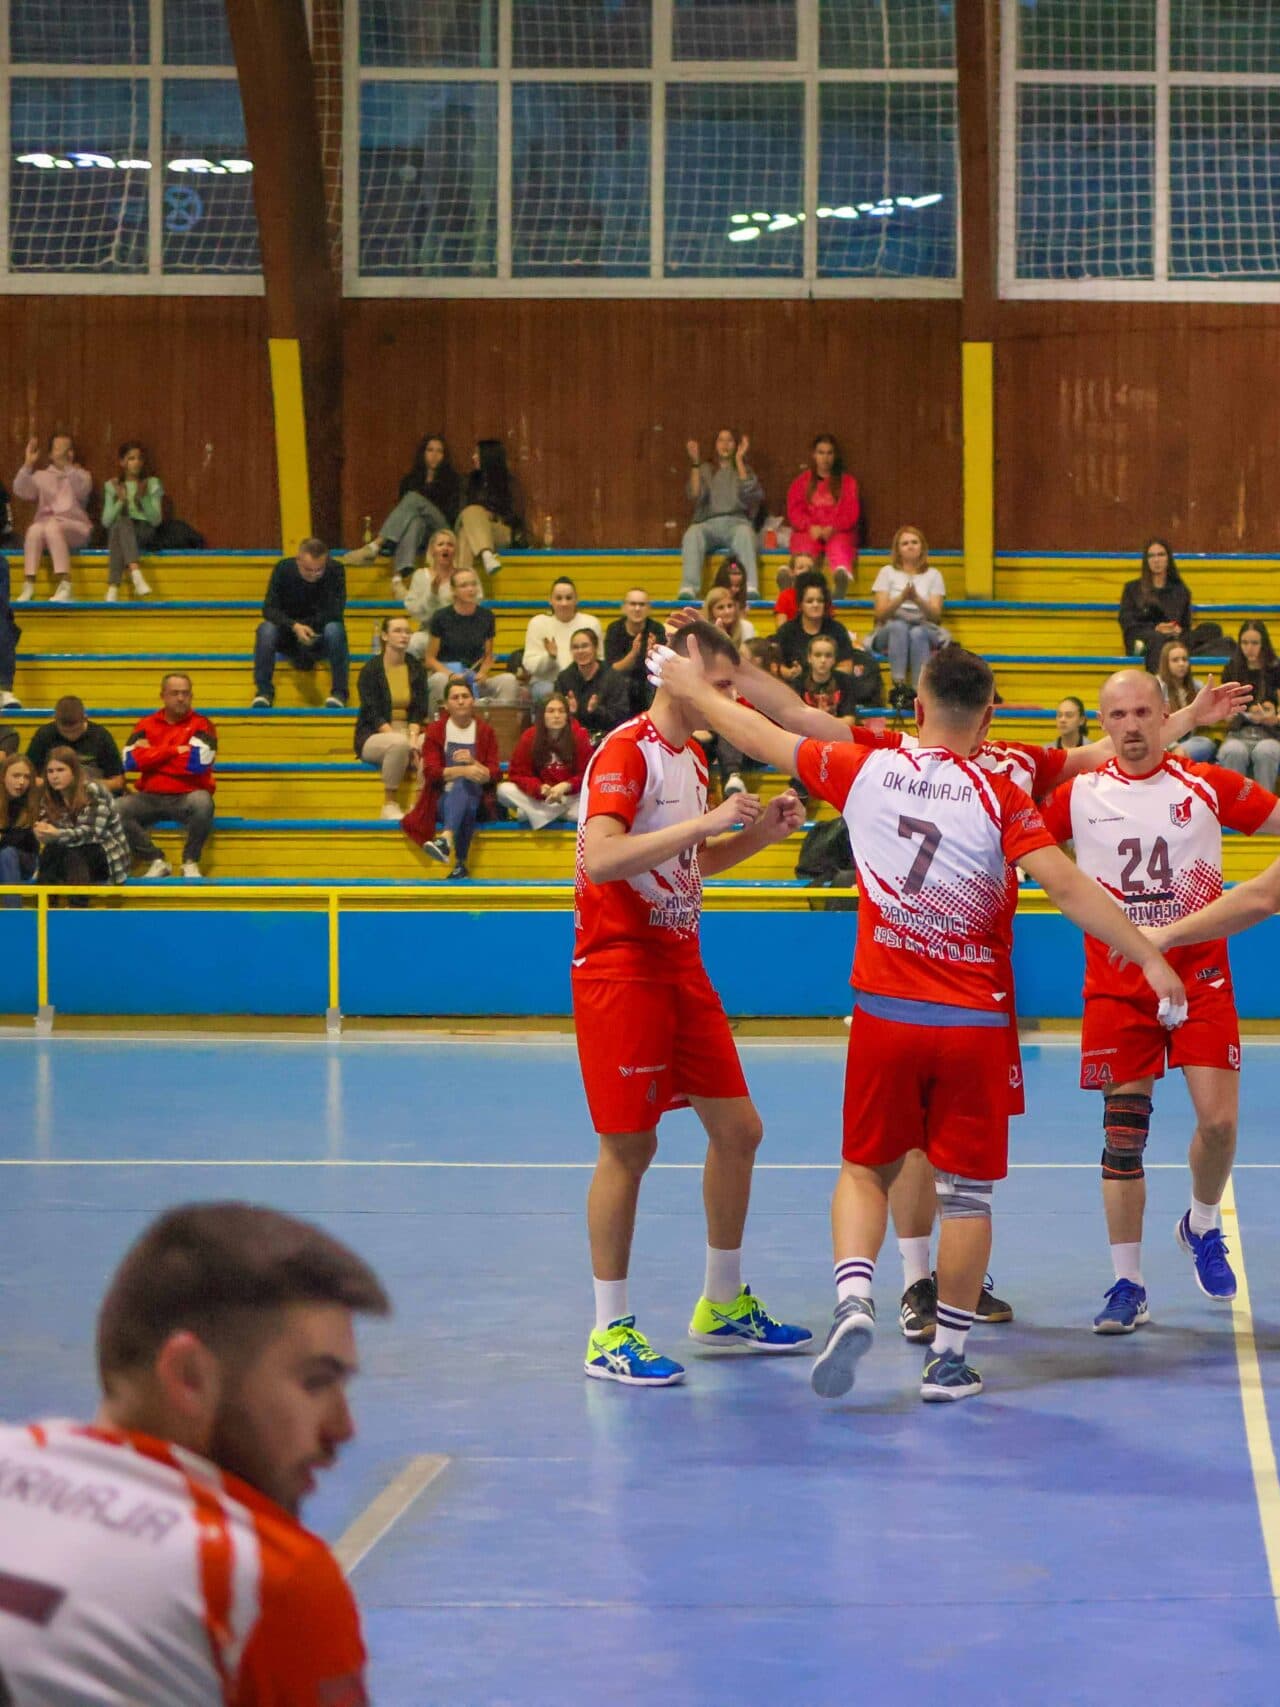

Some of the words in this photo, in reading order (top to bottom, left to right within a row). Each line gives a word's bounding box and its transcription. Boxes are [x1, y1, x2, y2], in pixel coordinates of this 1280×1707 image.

[883, 771, 906, 790] OK
[908, 777, 973, 803] KRIVAJA
[898, 814, 942, 896] 7
[1117, 836, 1174, 892] 24
[1084, 1062, 1114, 1086] 24
